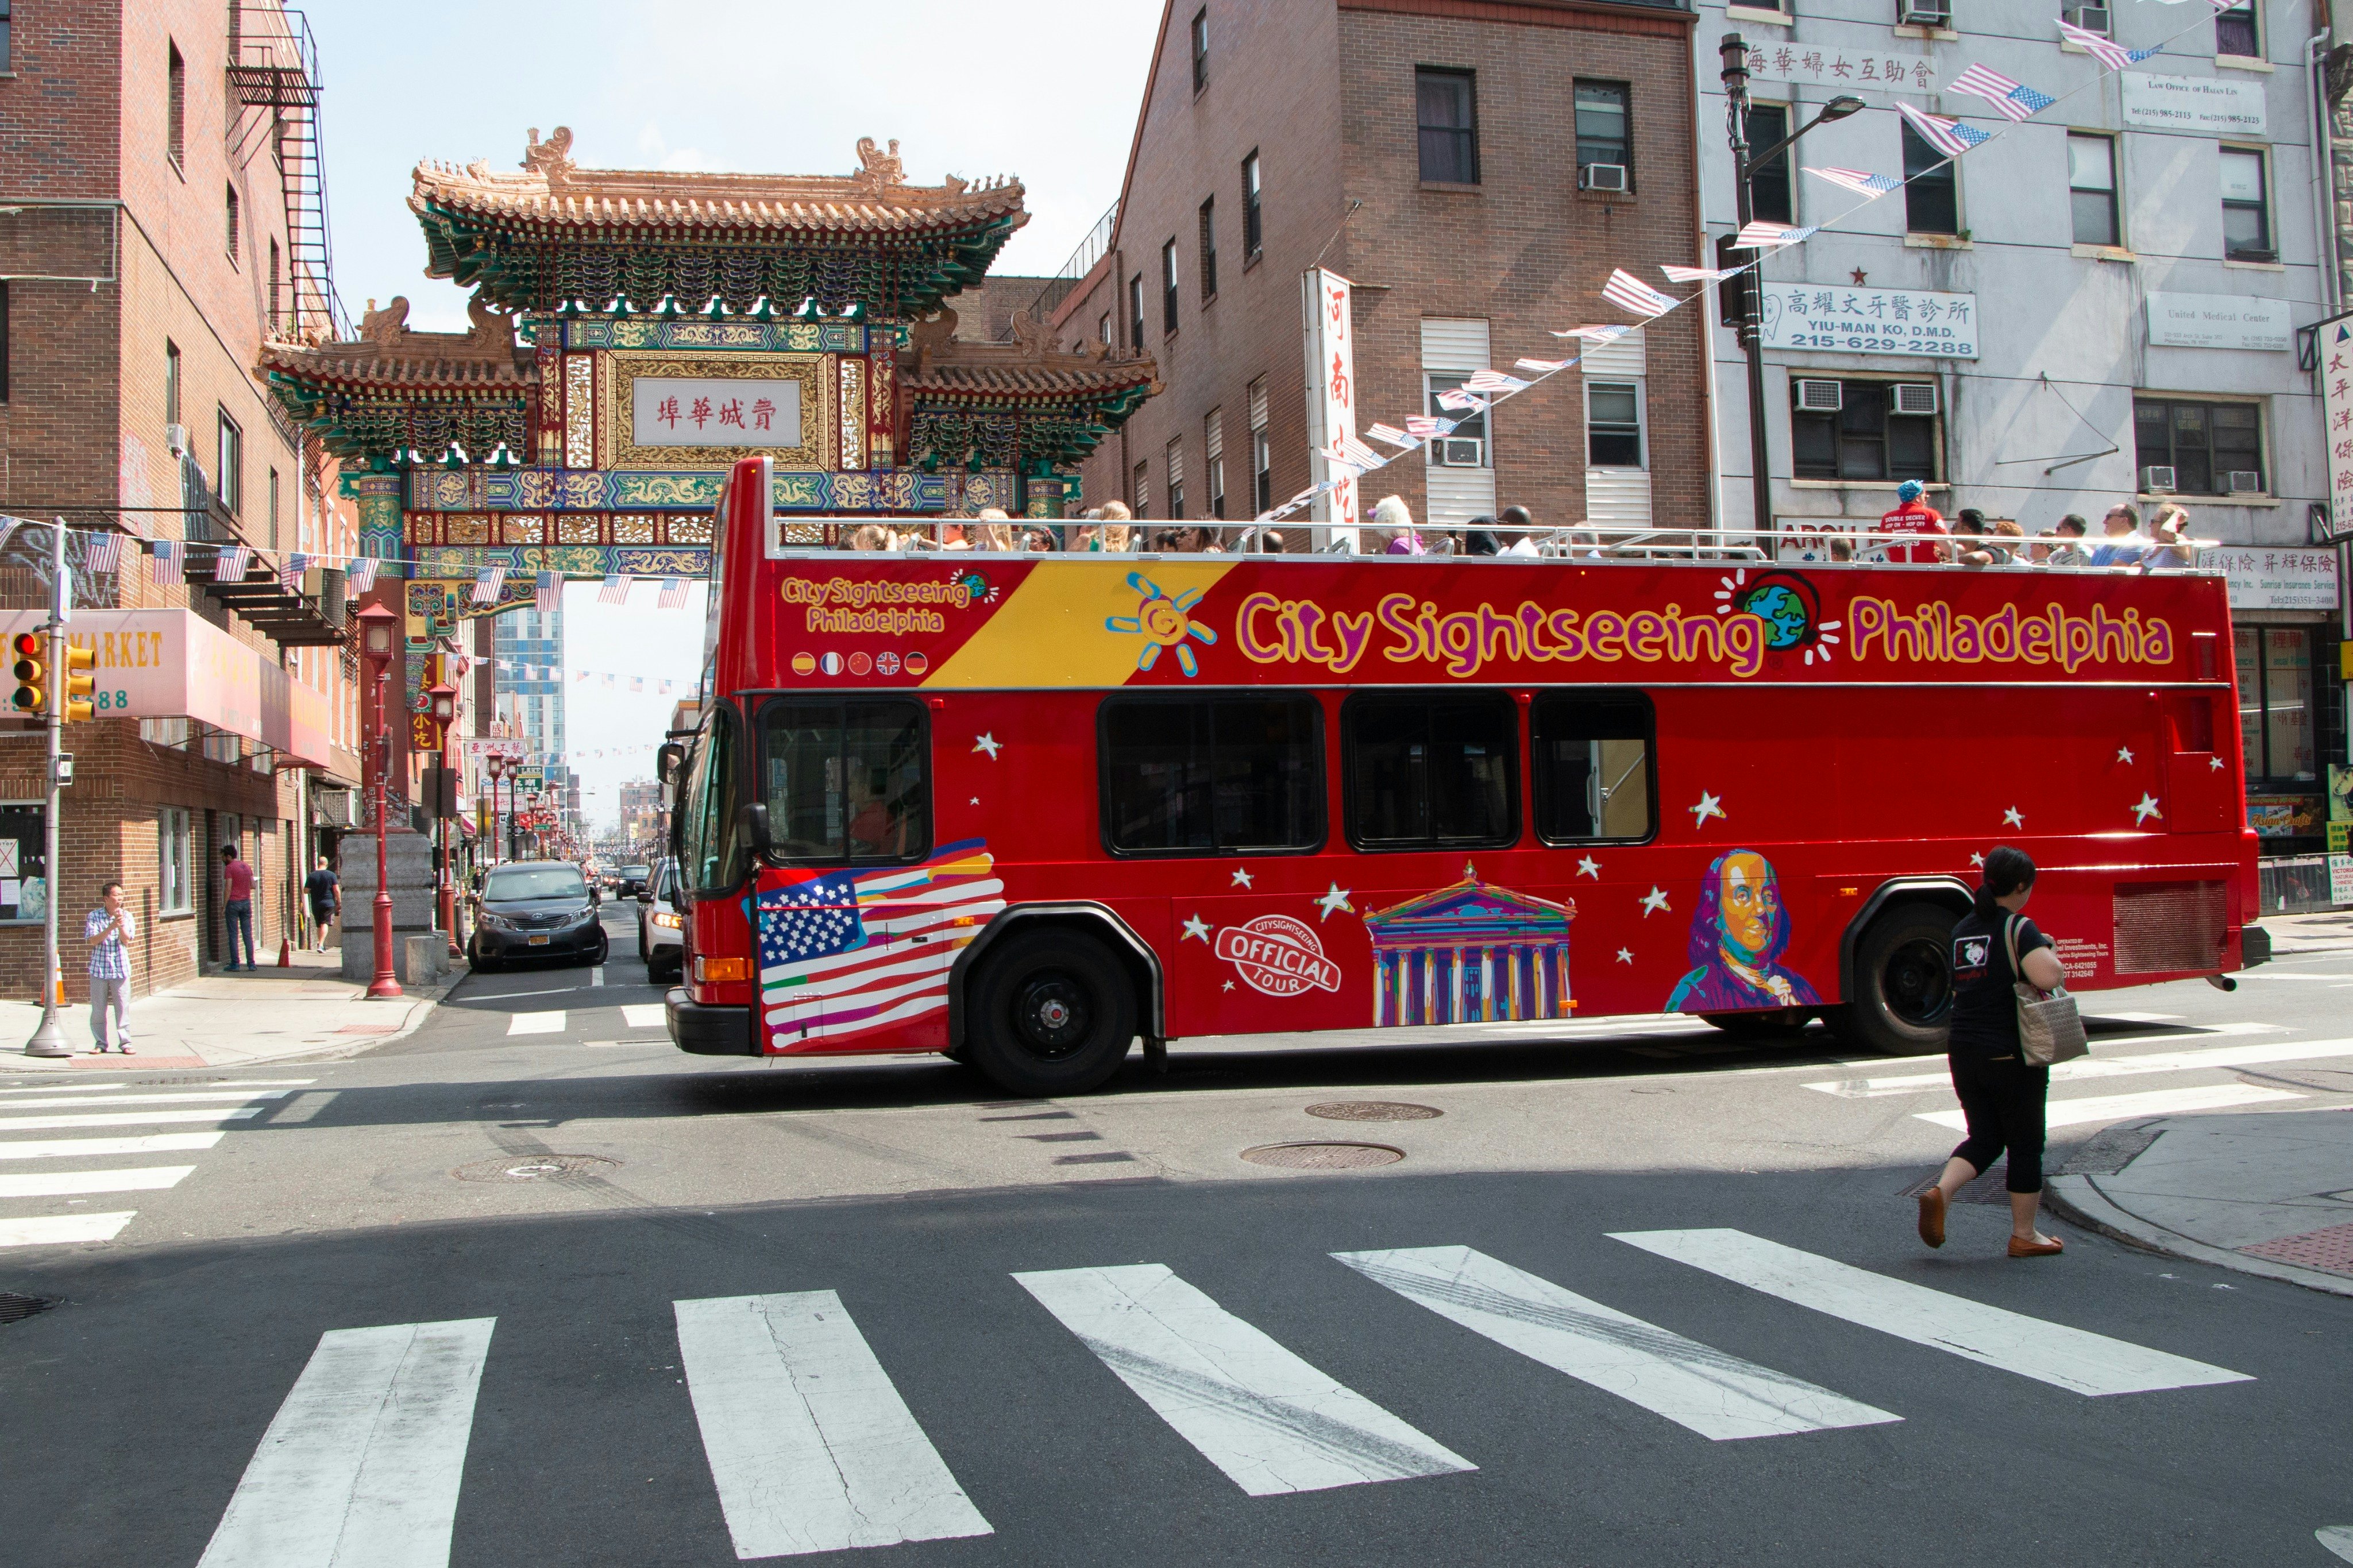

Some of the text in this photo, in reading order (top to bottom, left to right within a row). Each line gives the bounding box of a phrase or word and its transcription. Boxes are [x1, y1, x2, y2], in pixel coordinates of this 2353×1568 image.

[2168, 310, 2270, 323] United Medical Center
[1807, 320, 1955, 338] YIU-MAN KO, D.M.D.
[1791, 334, 1972, 354] 215-629-2288
[2328, 353, 2353, 491] 太平洋保險
[2260, 578, 2282, 589] Sunrise
[2283, 580, 2311, 590] Insurance
[2314, 580, 2335, 590] Service
[806, 606, 945, 636] Philadelphia
[1236, 592, 2174, 678] City Sightseeing Philadelphia
[2251, 813, 2312, 827] Asian Crafts
[1256, 920, 1318, 951] CITYSIGHTSEEING
[1230, 936, 1330, 986] OFFICIAL
[1253, 967, 1300, 991] TOUR
